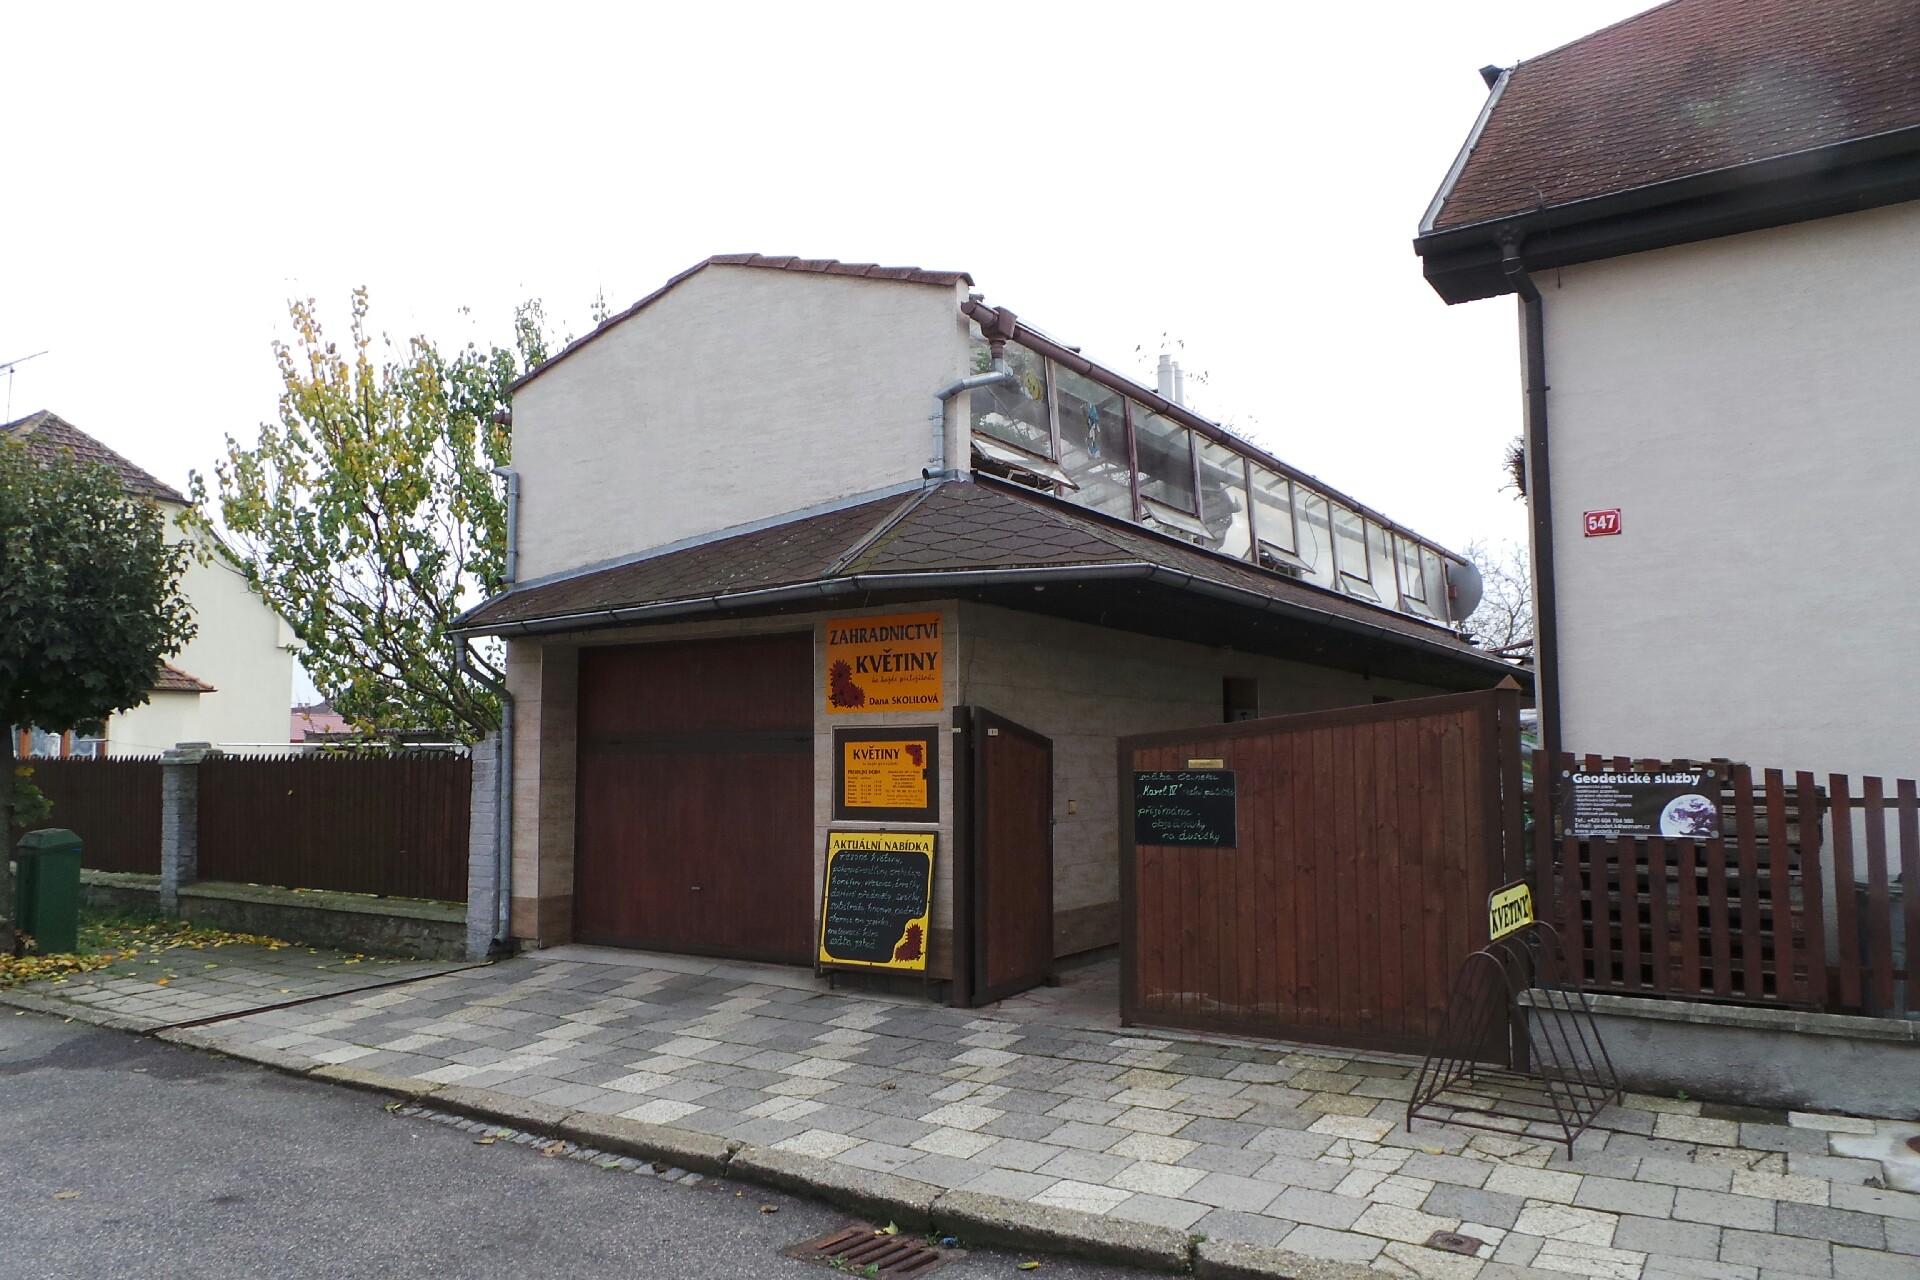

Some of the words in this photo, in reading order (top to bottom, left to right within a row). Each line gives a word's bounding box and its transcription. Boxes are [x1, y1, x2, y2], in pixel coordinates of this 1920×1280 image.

[1589, 515, 1615, 531] 547
[830, 618, 939, 645] ZAHRADNICTVÍ
[856, 648, 938, 673] KVĚTINY
[869, 697, 888, 706] Dana
[853, 745, 900, 760] KVĚTINY
[1573, 772, 1651, 784] Geodetické
[1655, 772, 1700, 786] služby
[833, 838, 882, 850] AKTUÁLNÍ
[884, 839, 929, 851] NABÍDKA
[1491, 895, 1529, 934] KVĚTINY
